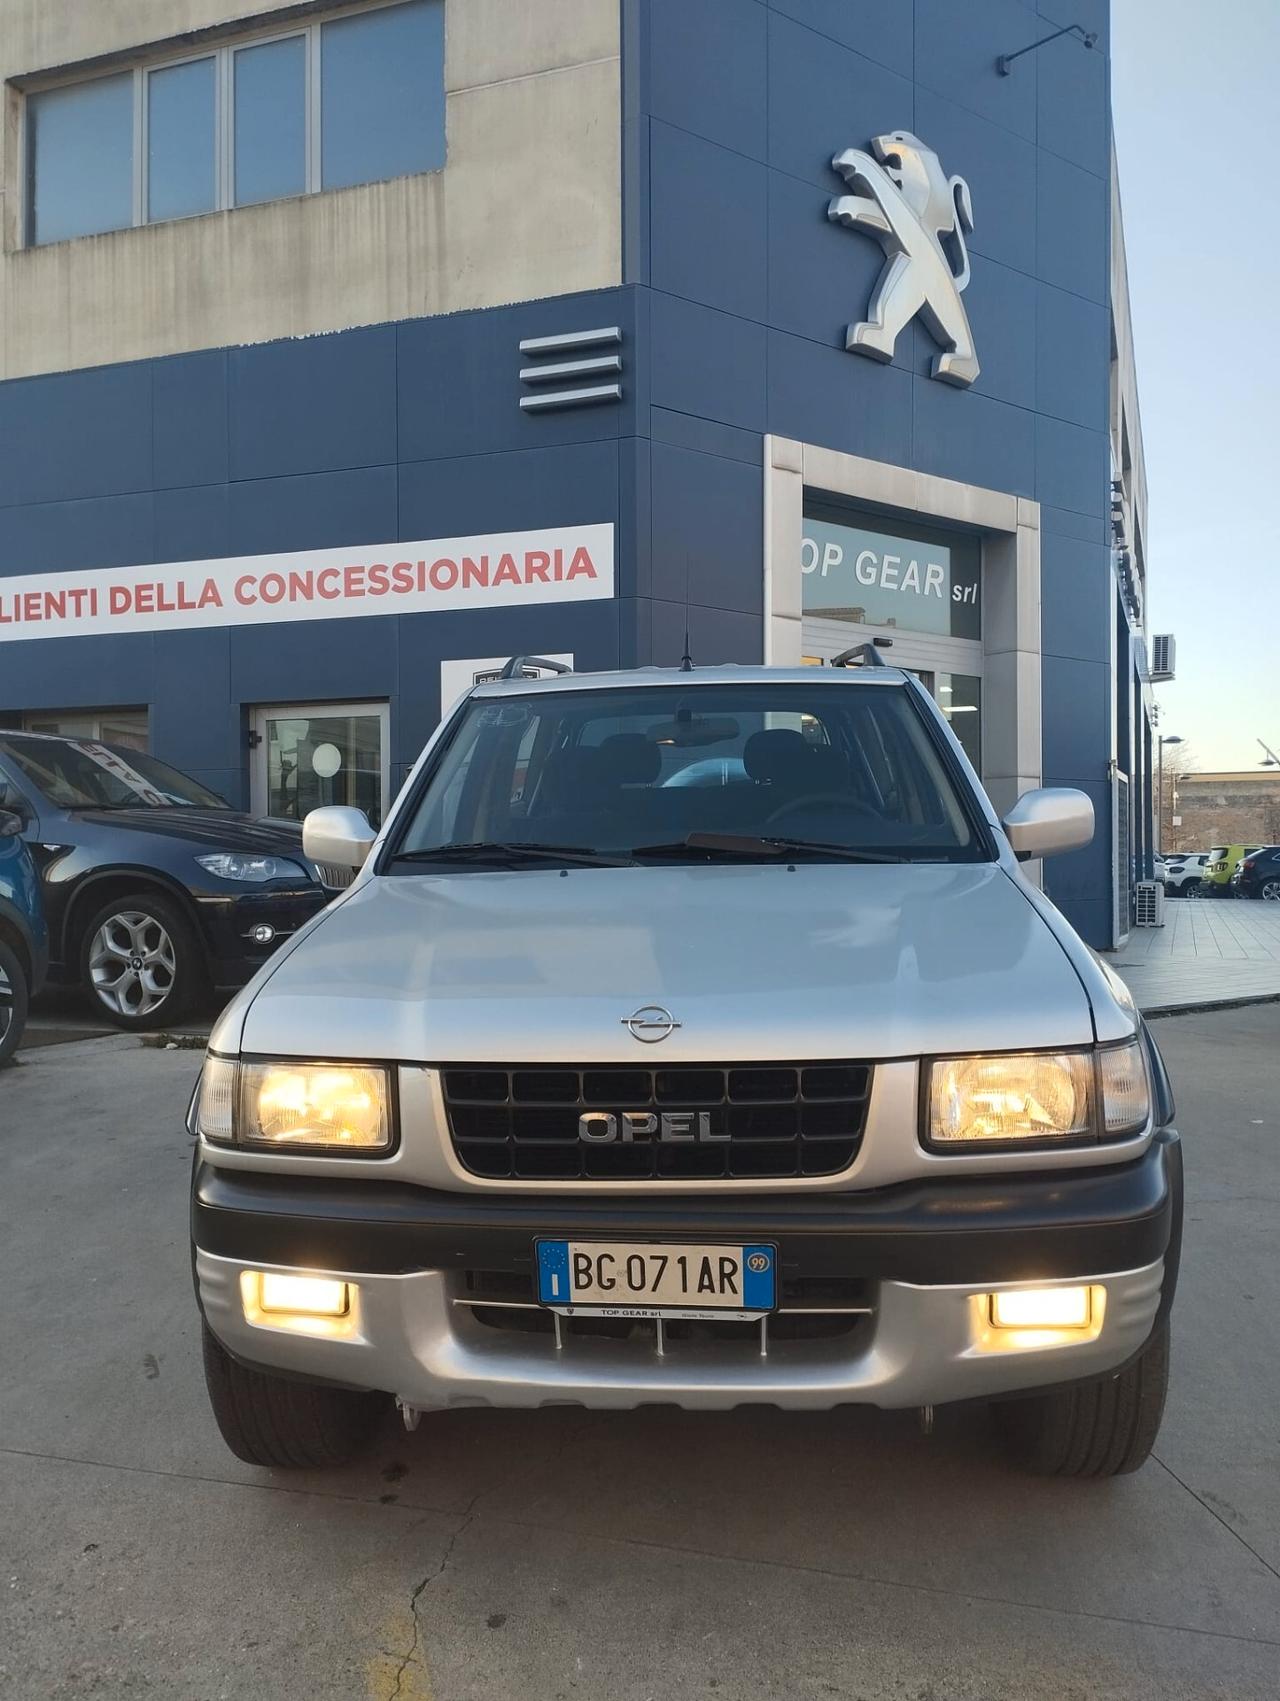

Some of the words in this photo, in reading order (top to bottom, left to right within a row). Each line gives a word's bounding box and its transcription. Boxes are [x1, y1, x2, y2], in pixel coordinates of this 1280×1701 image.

[109, 578, 224, 615] DELLA
[234, 546, 598, 606] CONCESSIONARIA
[855, 550, 945, 598] GEAR
[951, 583, 978, 604] srl
[578, 1112, 732, 1143] OPEL
[750, 1256, 767, 1269] 99
[622, 1309, 648, 1317] GEAR
